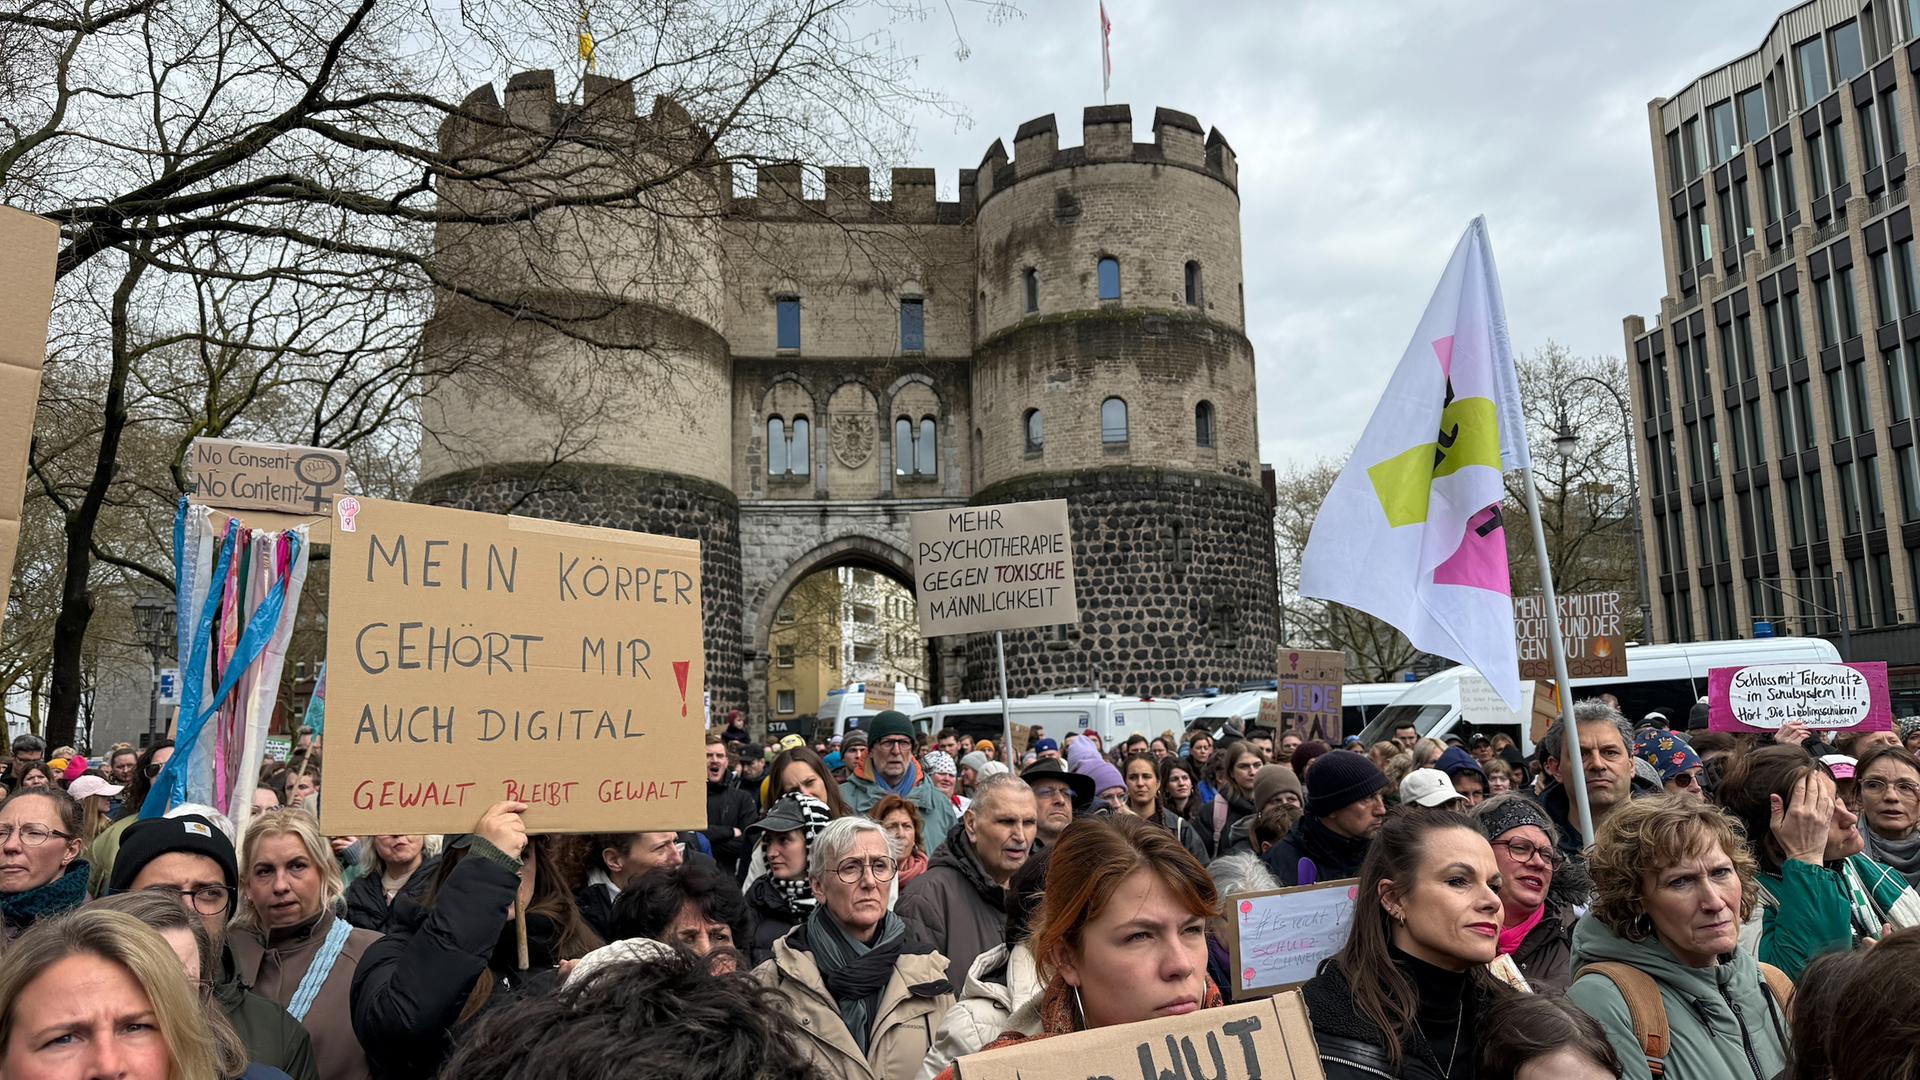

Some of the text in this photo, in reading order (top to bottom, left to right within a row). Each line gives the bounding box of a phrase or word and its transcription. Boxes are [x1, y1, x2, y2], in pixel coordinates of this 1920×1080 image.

[198, 444, 222, 465] No
[197, 472, 227, 498] No
[949, 509, 1004, 533] MEHR
[919, 533, 1064, 565] PSYCHOTHERAPIE
[367, 534, 693, 605] MEIN KÖRPER
[923, 560, 1065, 592] GEGEN TOXISCHE
[930, 587, 1061, 620] MÄNNLICHKEIT
[1569, 593, 1622, 616] MUTTER
[1565, 617, 1590, 637] UND
[1593, 615, 1621, 636] DER
[355, 622, 544, 676] GEHÖRT
[582, 636, 651, 680] MIR
[1735, 669, 1863, 688] Schluss mit Täterschutz
[1280, 683, 1338, 713] JEDE
[1747, 691, 1762, 702] im
[354, 704, 645, 744] AUCH DIGITAL
[1281, 712, 1340, 742] FRAU
[1737, 706, 1762, 721] Hört
[353, 779, 688, 810] GEWALT BLEIBT GEWALT
[1136, 1015, 1263, 1080] WUT
